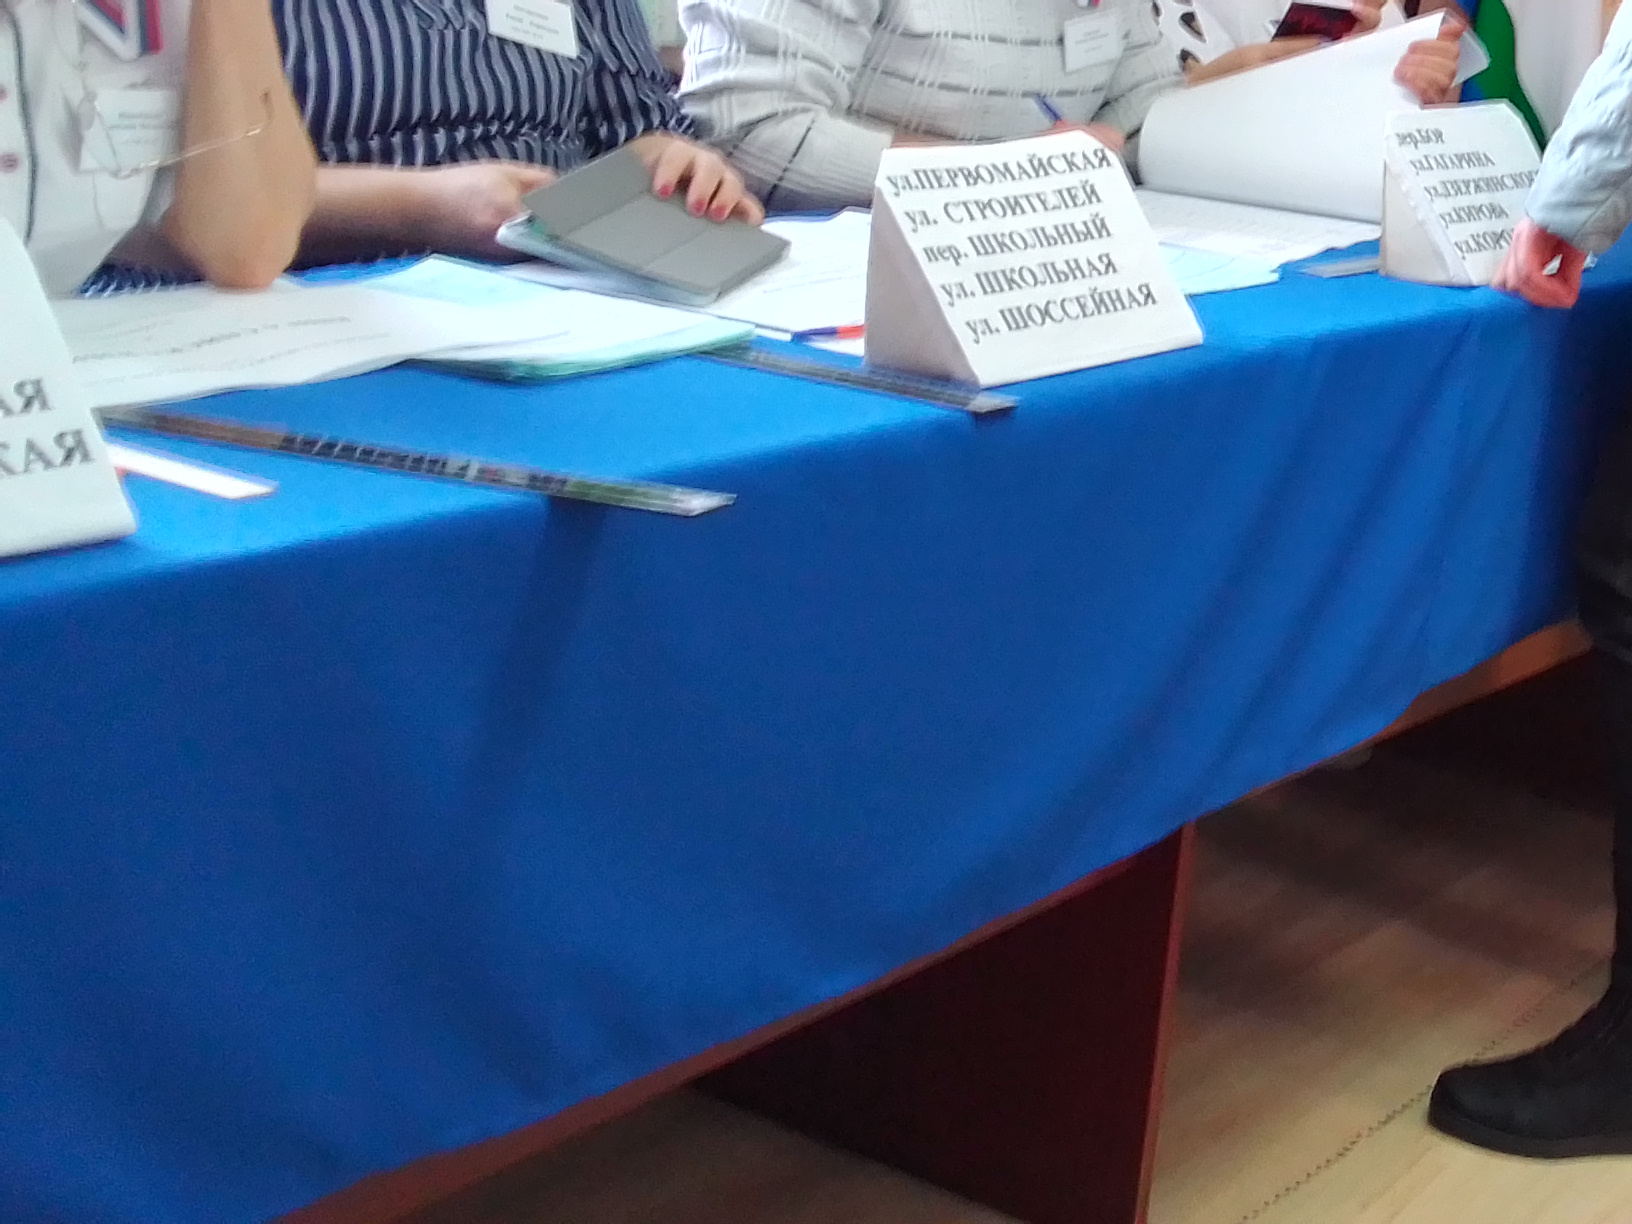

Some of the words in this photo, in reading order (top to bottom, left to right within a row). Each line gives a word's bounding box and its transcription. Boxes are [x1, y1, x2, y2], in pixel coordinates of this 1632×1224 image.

[904, 209, 938, 233] ул.
[942, 179, 1103, 224] СТРОИТЕЛЕЙ
[922, 244, 969, 266] пер.
[967, 212, 1112, 257] ШКОЛЬНЫЙ
[940, 281, 976, 307] ул.
[974, 252, 1118, 295] ШКОЛЬНАЯ
[965, 317, 1000, 344] ул.
[997, 283, 1158, 332] ШОССЕЙНАЯ
